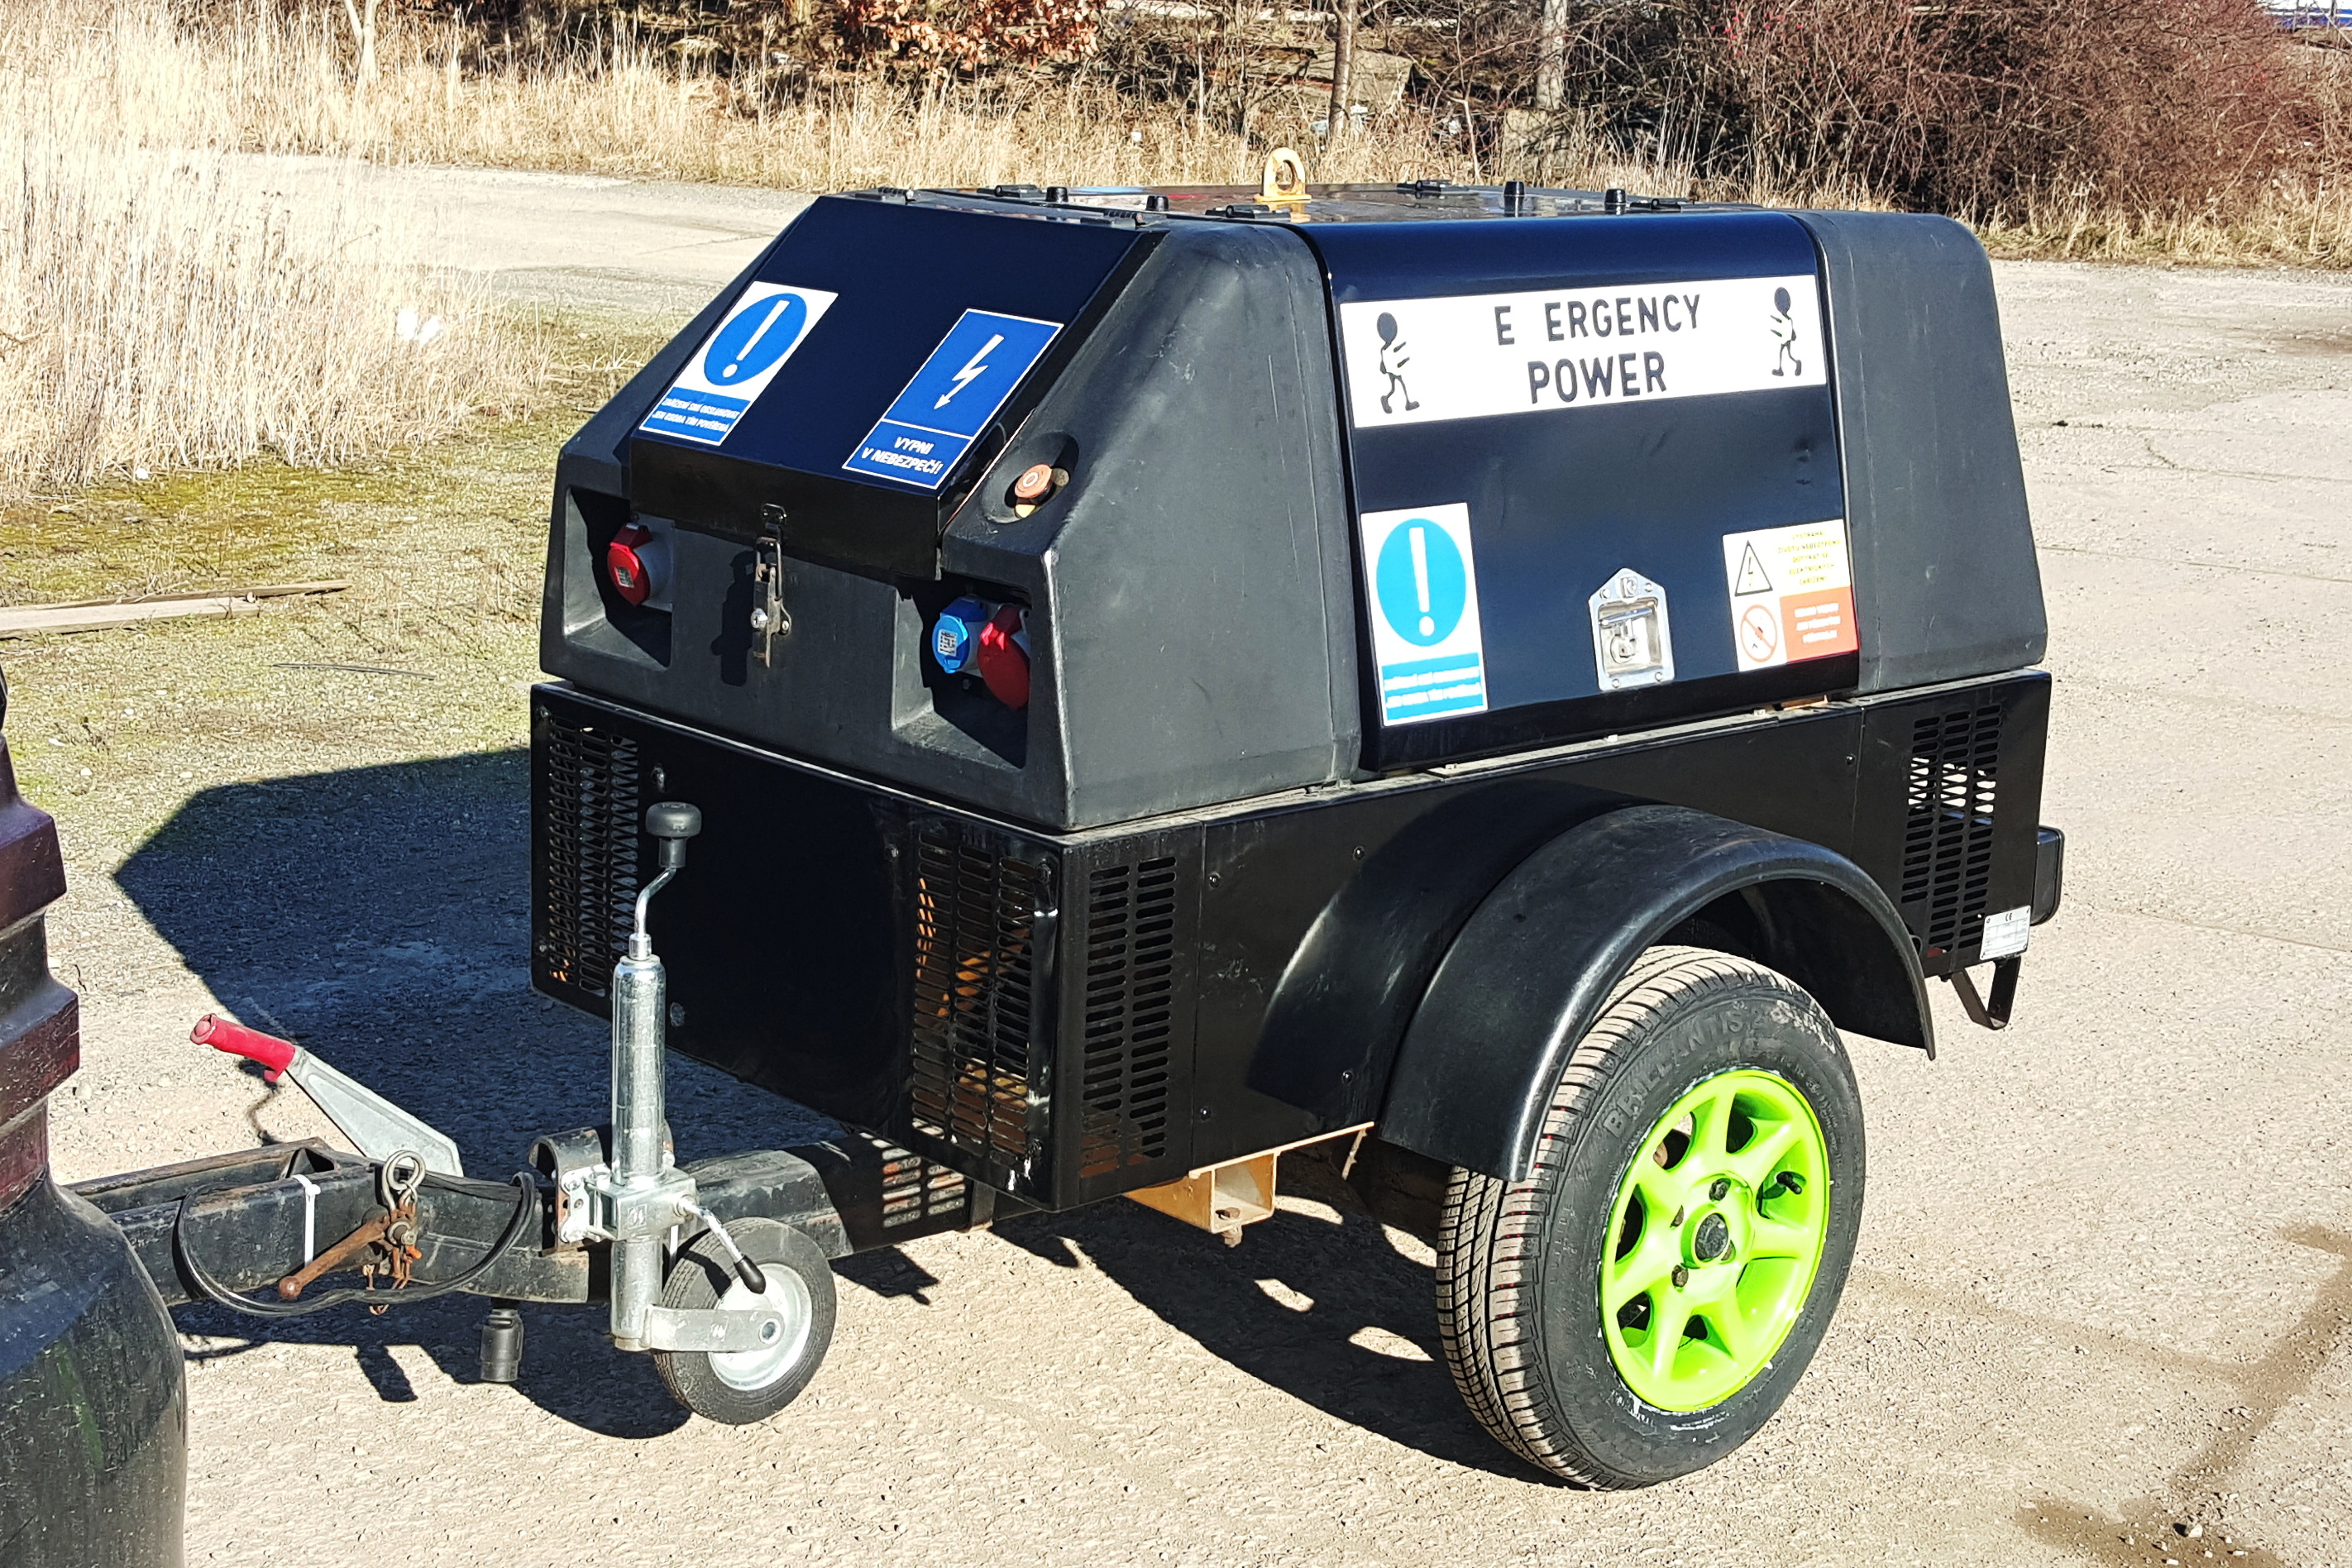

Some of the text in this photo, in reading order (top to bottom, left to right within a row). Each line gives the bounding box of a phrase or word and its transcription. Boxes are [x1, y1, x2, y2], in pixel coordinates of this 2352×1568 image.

[1527, 351, 1666, 405] POWER
[893, 437, 935, 455] VYPNI
[861, 447, 944, 475] V NEBEZPEČÍ!
